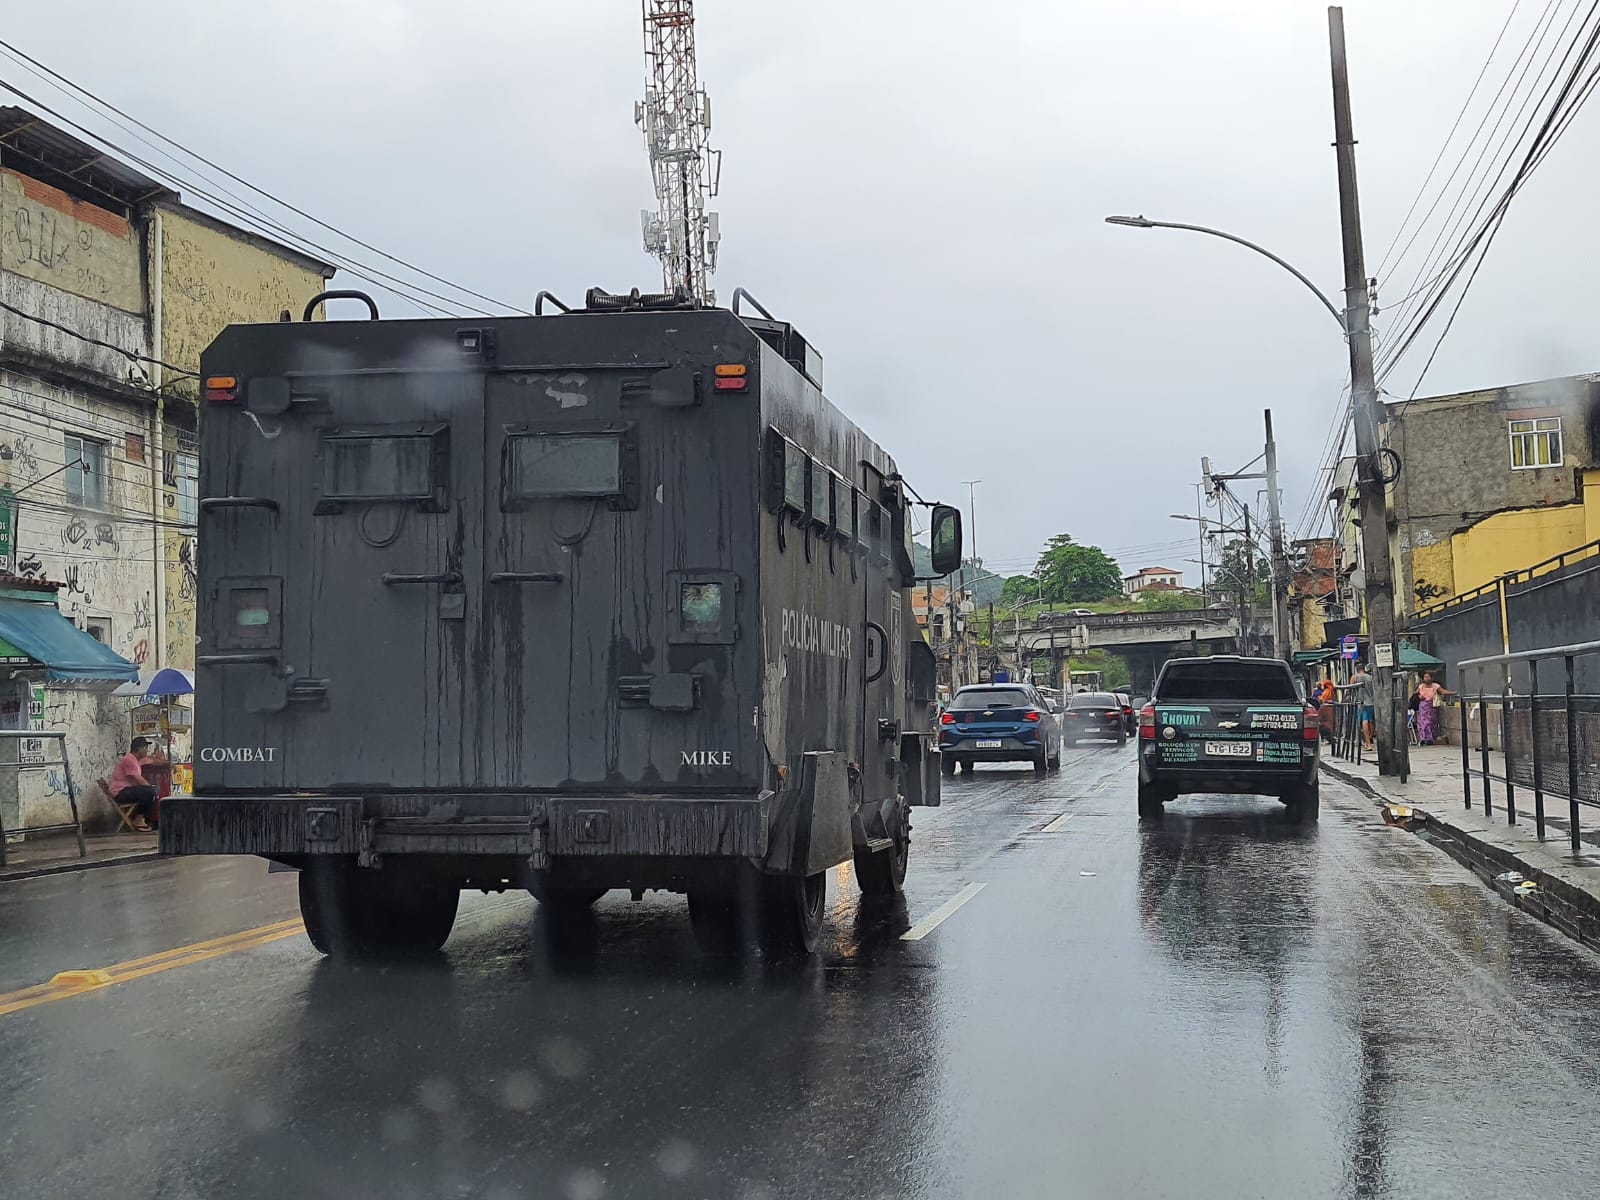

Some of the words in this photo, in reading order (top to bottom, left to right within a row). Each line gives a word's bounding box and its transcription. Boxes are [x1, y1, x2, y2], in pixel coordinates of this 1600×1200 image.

[782, 603, 820, 655] POLÍCIA
[820, 620, 850, 659] MILITAR
[200, 747, 278, 762] COMBAT
[680, 751, 732, 766] MIKE
